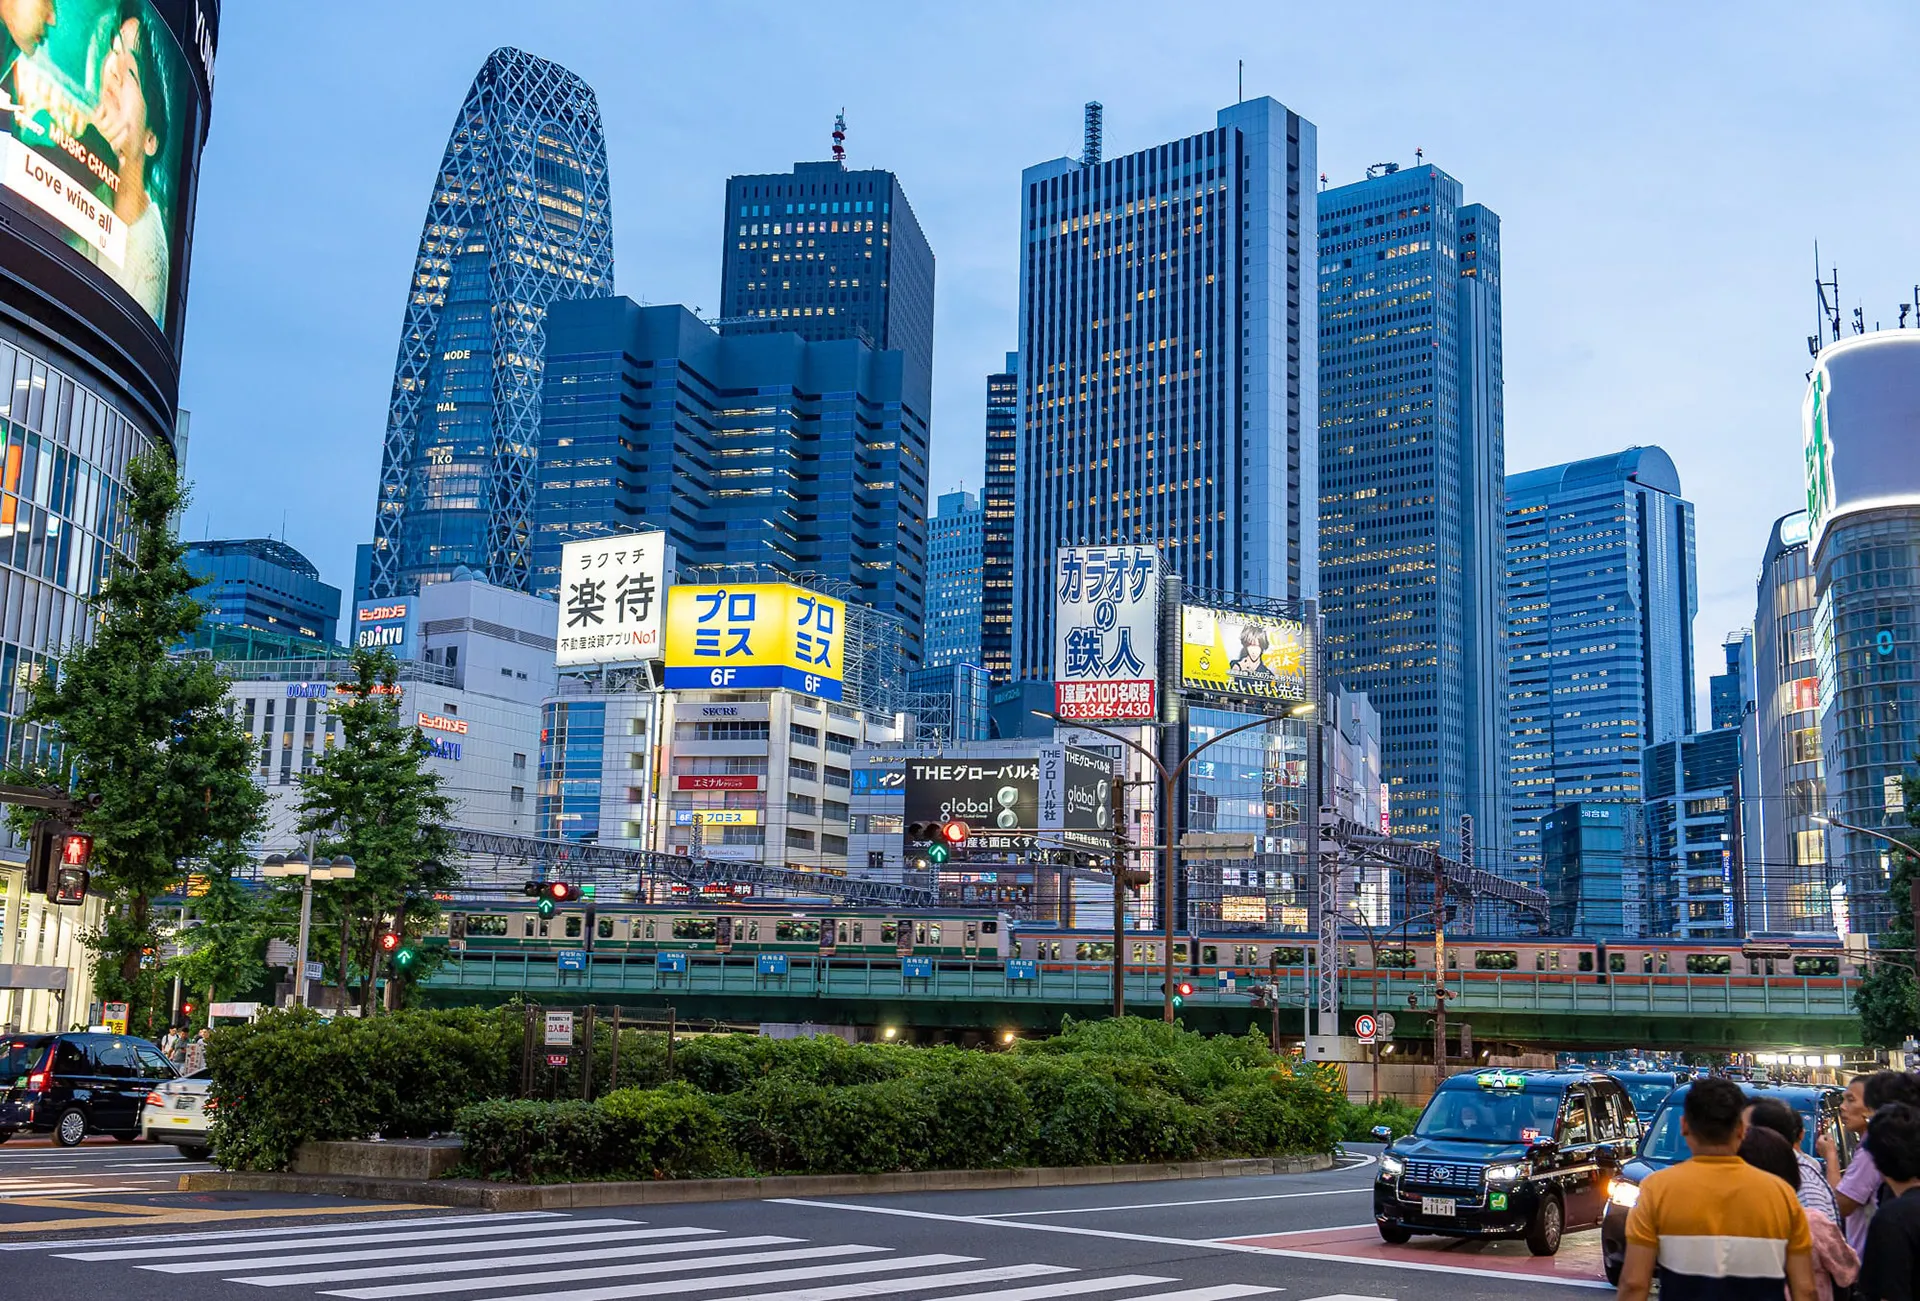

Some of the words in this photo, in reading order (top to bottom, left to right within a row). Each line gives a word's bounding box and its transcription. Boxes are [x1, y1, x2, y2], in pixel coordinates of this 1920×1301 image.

[49, 121, 87, 163] MUSIC
[87, 152, 120, 192] CHART
[25, 154, 62, 195] Love
[66, 187, 95, 221] wins
[98, 214, 112, 235] all
[443, 350, 471, 360] MODE
[436, 403, 457, 412] HAL
[432, 455, 453, 464] IKO
[580, 548, 645, 570] ラクマチ
[1059, 547, 1154, 604] カラオケ
[566, 572, 656, 628] 楽待
[695, 589, 756, 623] プロ
[359, 604, 407, 622] ビックカメラ
[797, 596, 834, 634] プロ
[1094, 598, 1117, 632] の
[359, 627, 403, 648] ODAKYU
[694, 628, 754, 657] ミス
[795, 631, 832, 668] ミス
[1065, 626, 1145, 678] 鉄人
[710, 668, 736, 686] 6F
[804, 674, 821, 693] 6F
[1226, 677, 1304, 700] たいせい先生
[286, 683, 328, 698] ODAKYU
[702, 707, 738, 716] SECRE
[1060, 703, 1150, 717] 03-3345-6430
[418, 712, 468, 735] ビックカメラ
[1065, 751, 1111, 774] THEグローバル社
[940, 797, 993, 823] global
[1068, 785, 1096, 813] global
[707, 813, 742, 822] プロミス
[548, 1024, 570, 1033] 立入禁止
